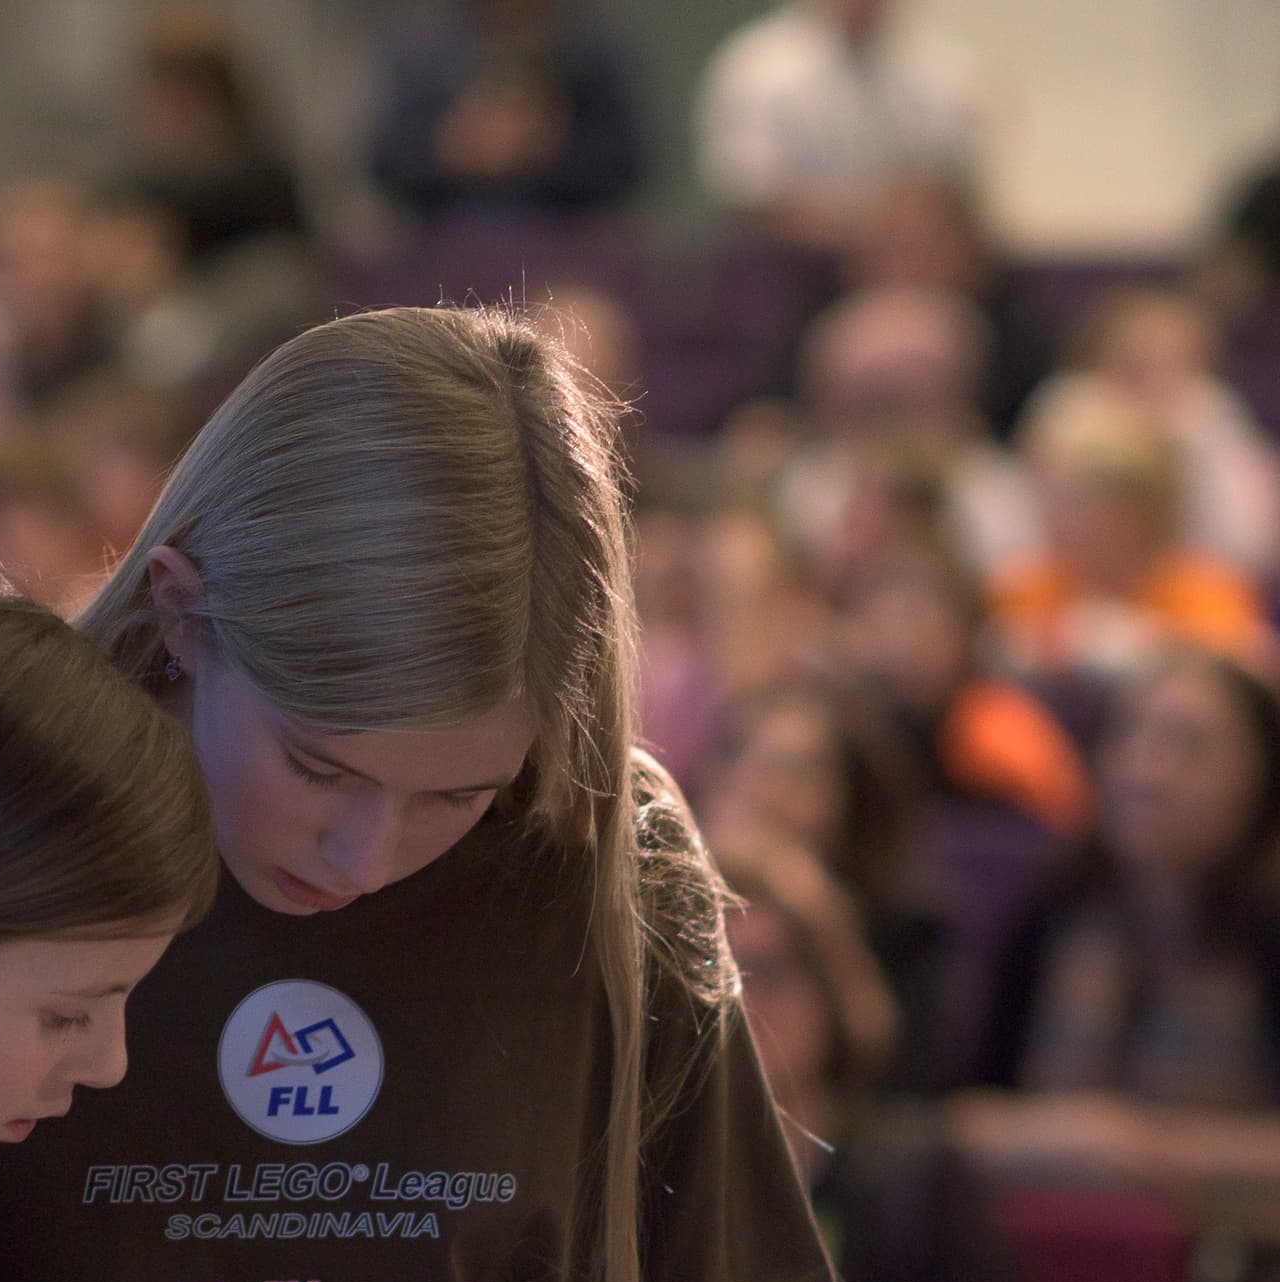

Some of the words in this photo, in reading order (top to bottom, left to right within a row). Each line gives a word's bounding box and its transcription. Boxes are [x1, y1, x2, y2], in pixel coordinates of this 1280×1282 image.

[267, 1085, 340, 1117] FLL
[82, 1163, 218, 1203] FIRST
[370, 1163, 518, 1210] League
[164, 1212, 440, 1240] SCANDINAVIA
